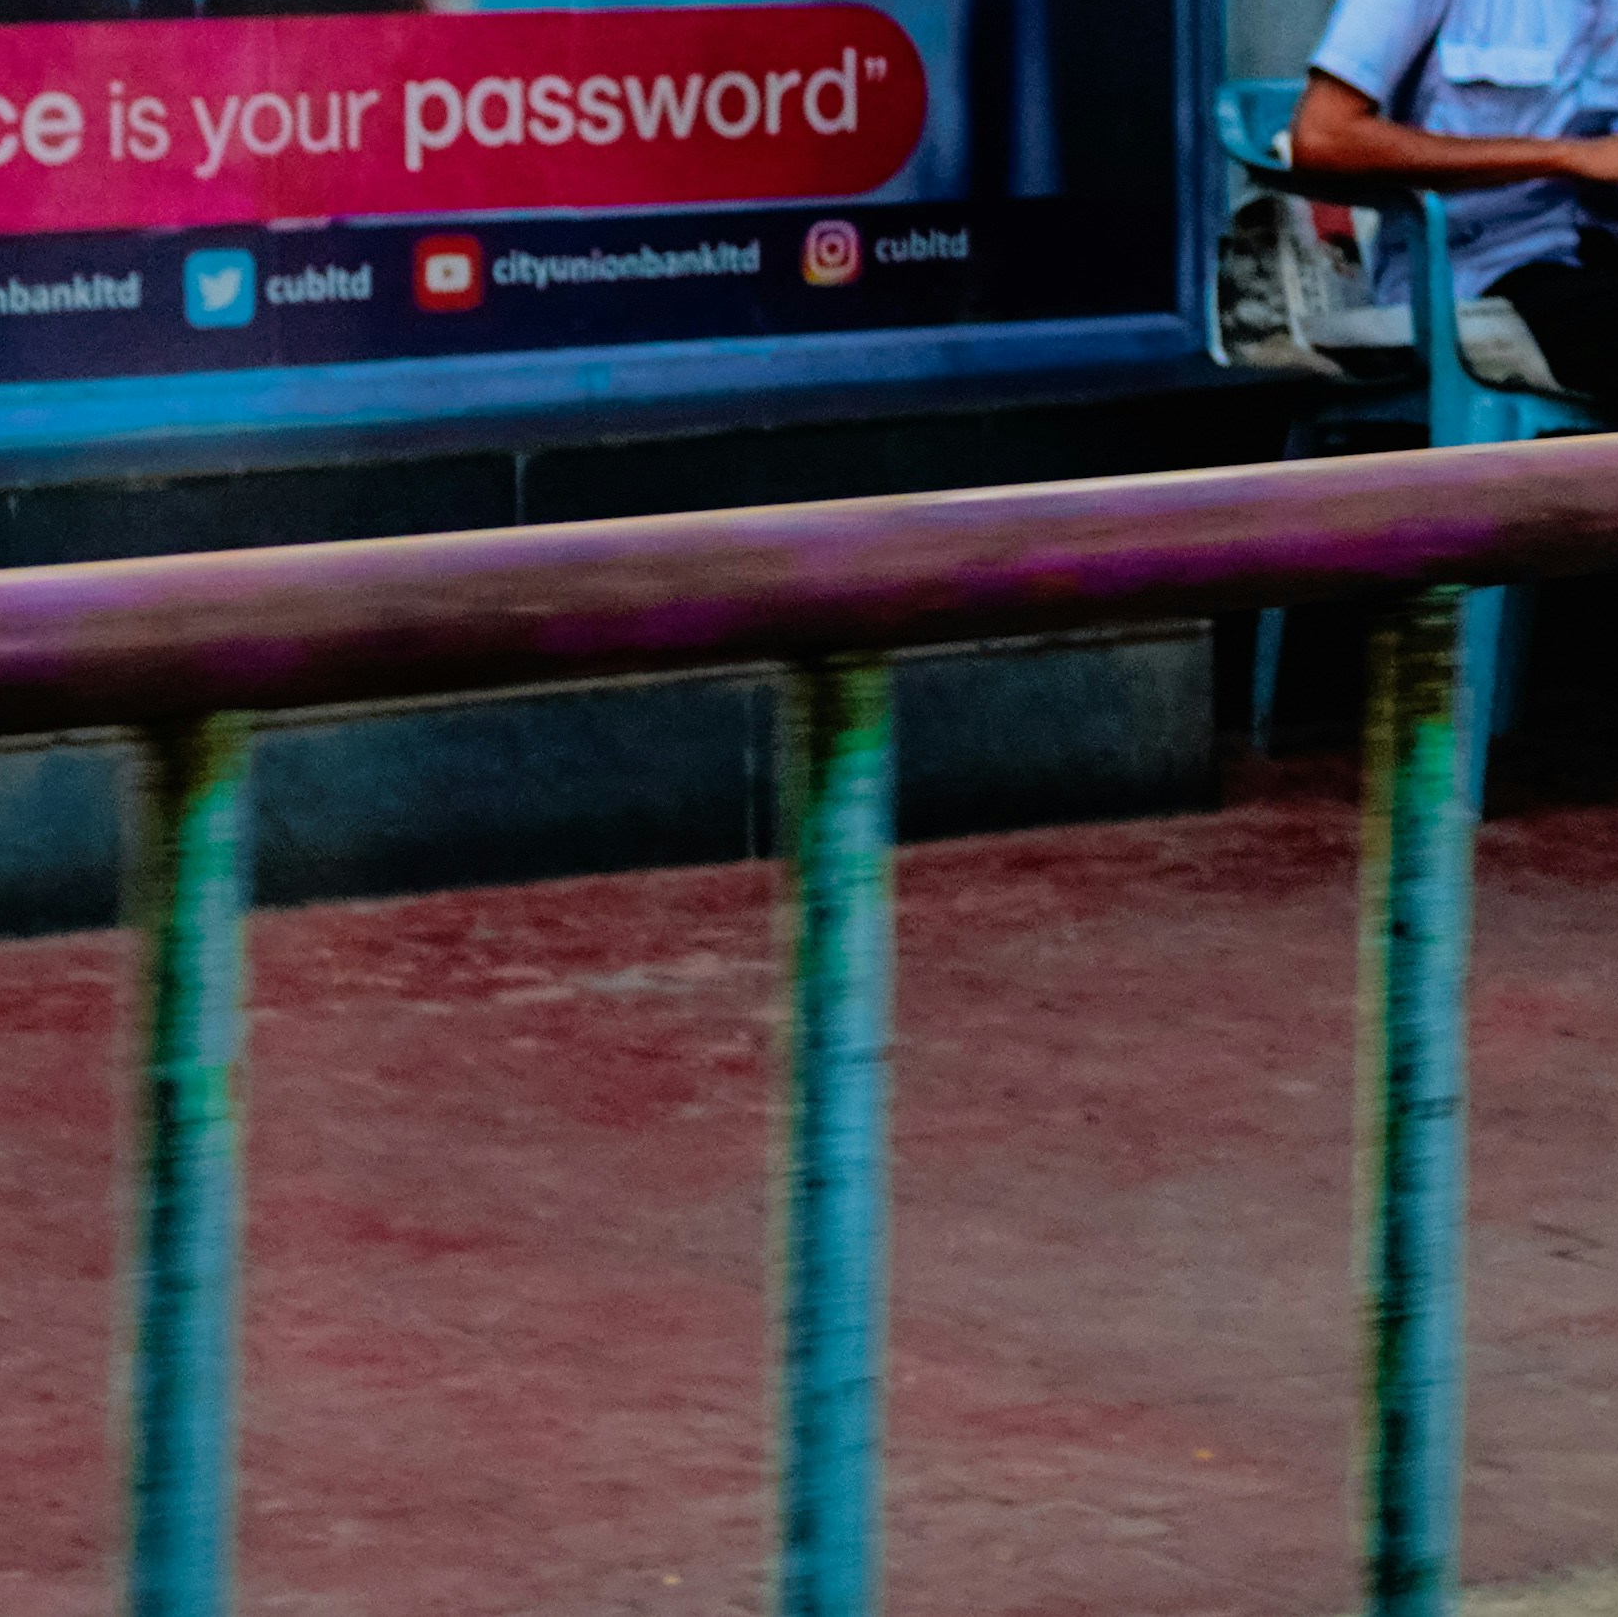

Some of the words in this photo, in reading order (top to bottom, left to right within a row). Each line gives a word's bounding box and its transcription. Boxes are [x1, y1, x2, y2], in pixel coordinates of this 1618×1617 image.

[109, 81, 171, 163] is
[192, 86, 380, 180] your
[403, 46, 887, 172] password”
[267, 264, 372, 308] cubltd
[491, 241, 762, 290] cityunionbankltd
[874, 228, 970, 266] cubltd
